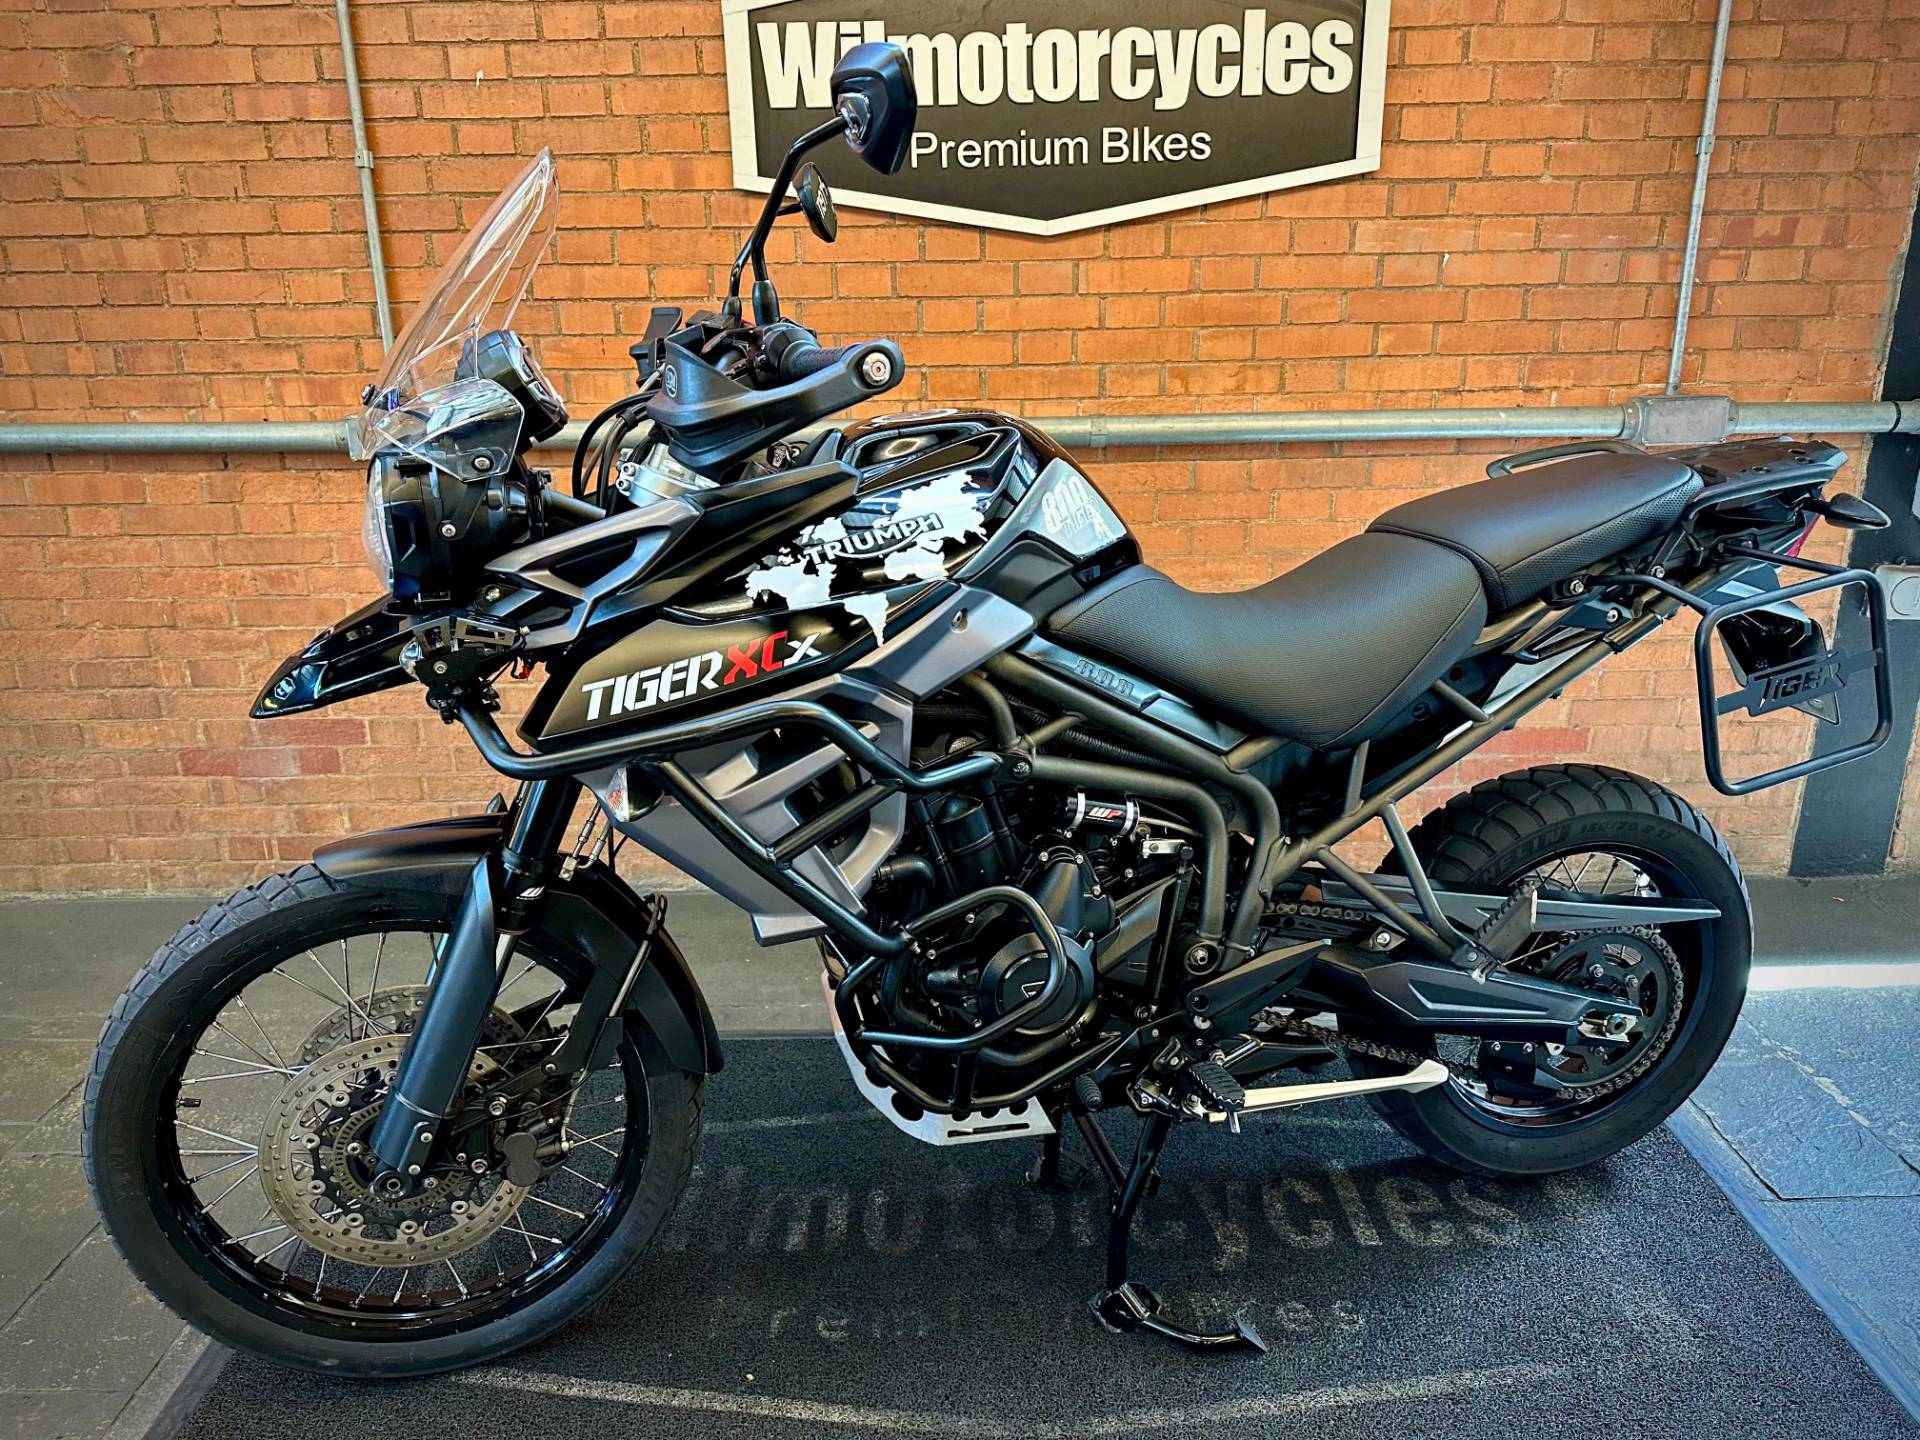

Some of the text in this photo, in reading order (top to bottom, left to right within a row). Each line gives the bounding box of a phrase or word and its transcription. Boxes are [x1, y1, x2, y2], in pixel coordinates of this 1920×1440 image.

[756, 9, 1354, 110] Wmotorcycles
[910, 130, 1089, 168] Premium
[1041, 475, 1088, 534] 800
[803, 512, 942, 564] TRIUMPH
[1753, 659, 1847, 710] TIGER
[1088, 806, 1125, 819] WP
